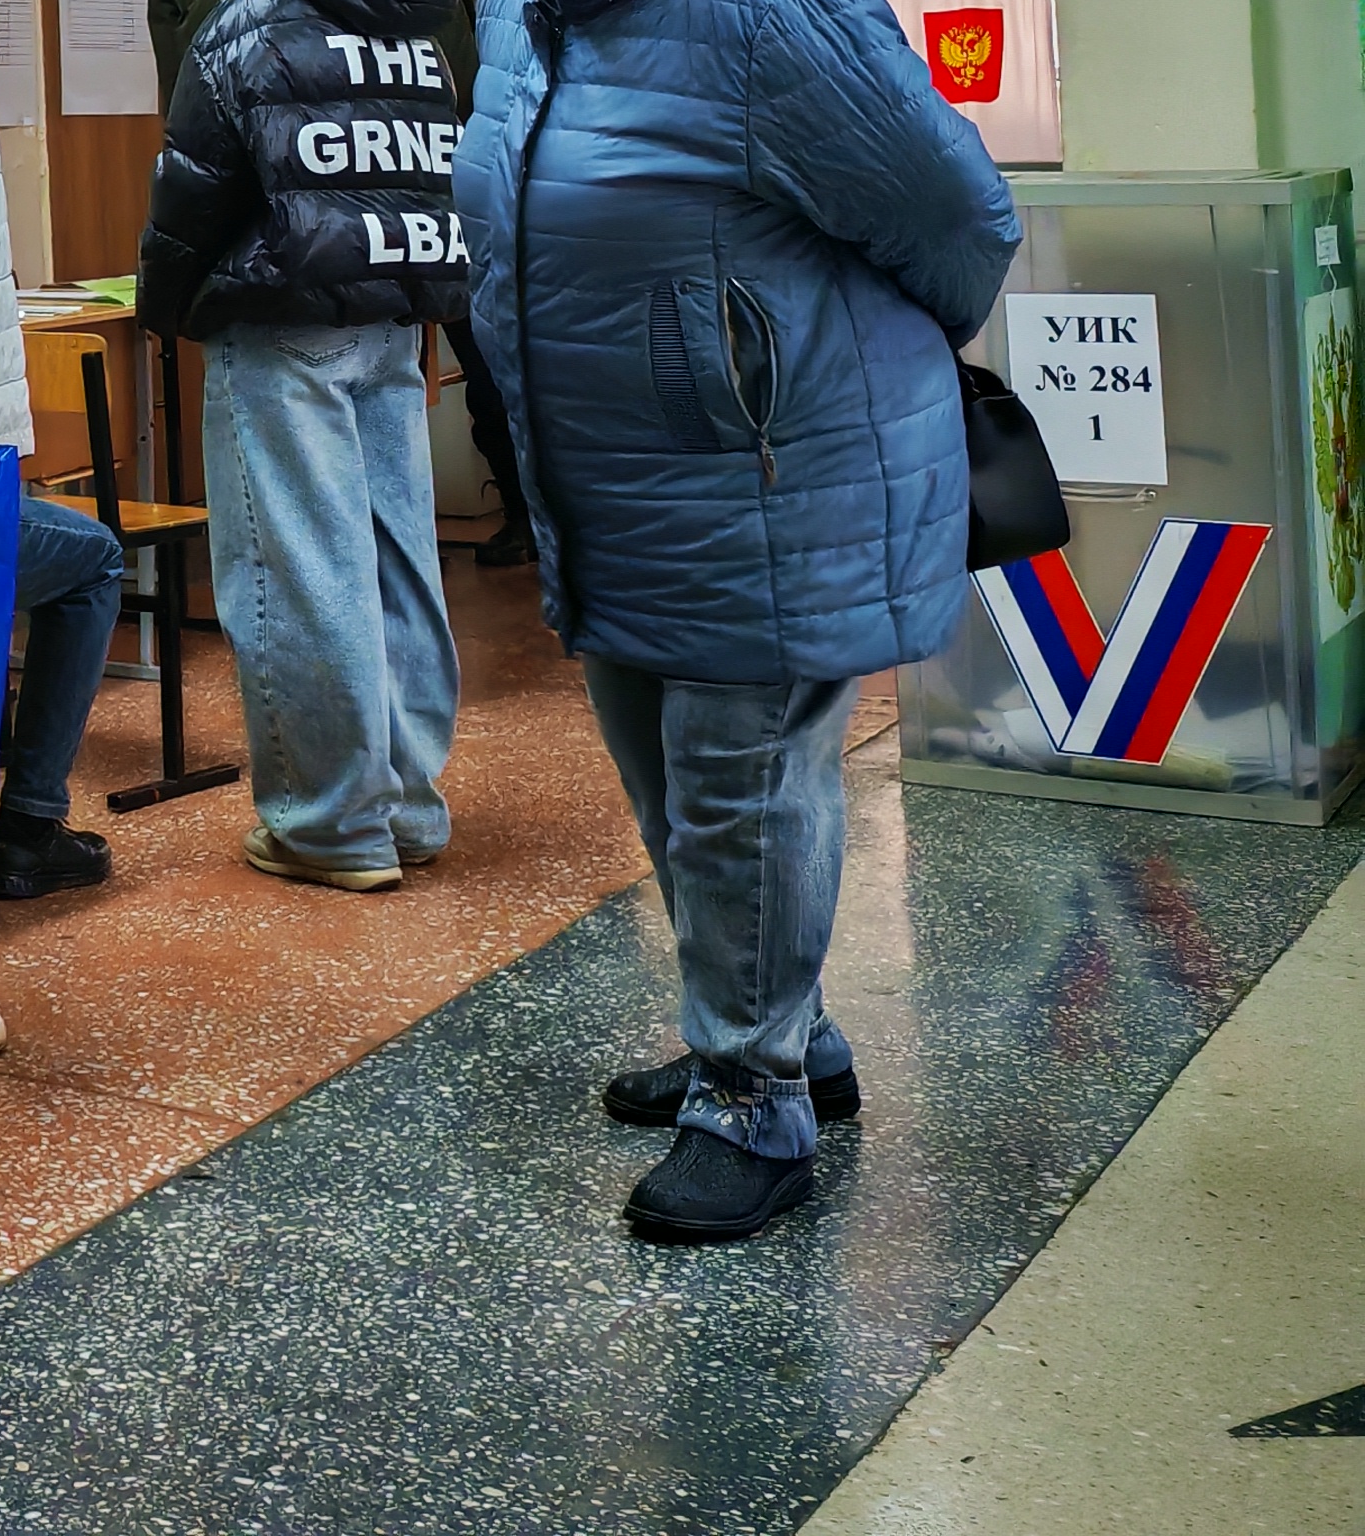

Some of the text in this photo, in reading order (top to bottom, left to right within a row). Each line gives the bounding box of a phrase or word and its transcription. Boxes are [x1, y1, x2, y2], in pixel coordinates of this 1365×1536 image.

[326, 34, 442, 89] THE
[297, 119, 464, 175] GRNE
[1042, 316, 1138, 344] УИК
[1035, 364, 1152, 393] № 284
[1087, 414, 1105, 441] 1
